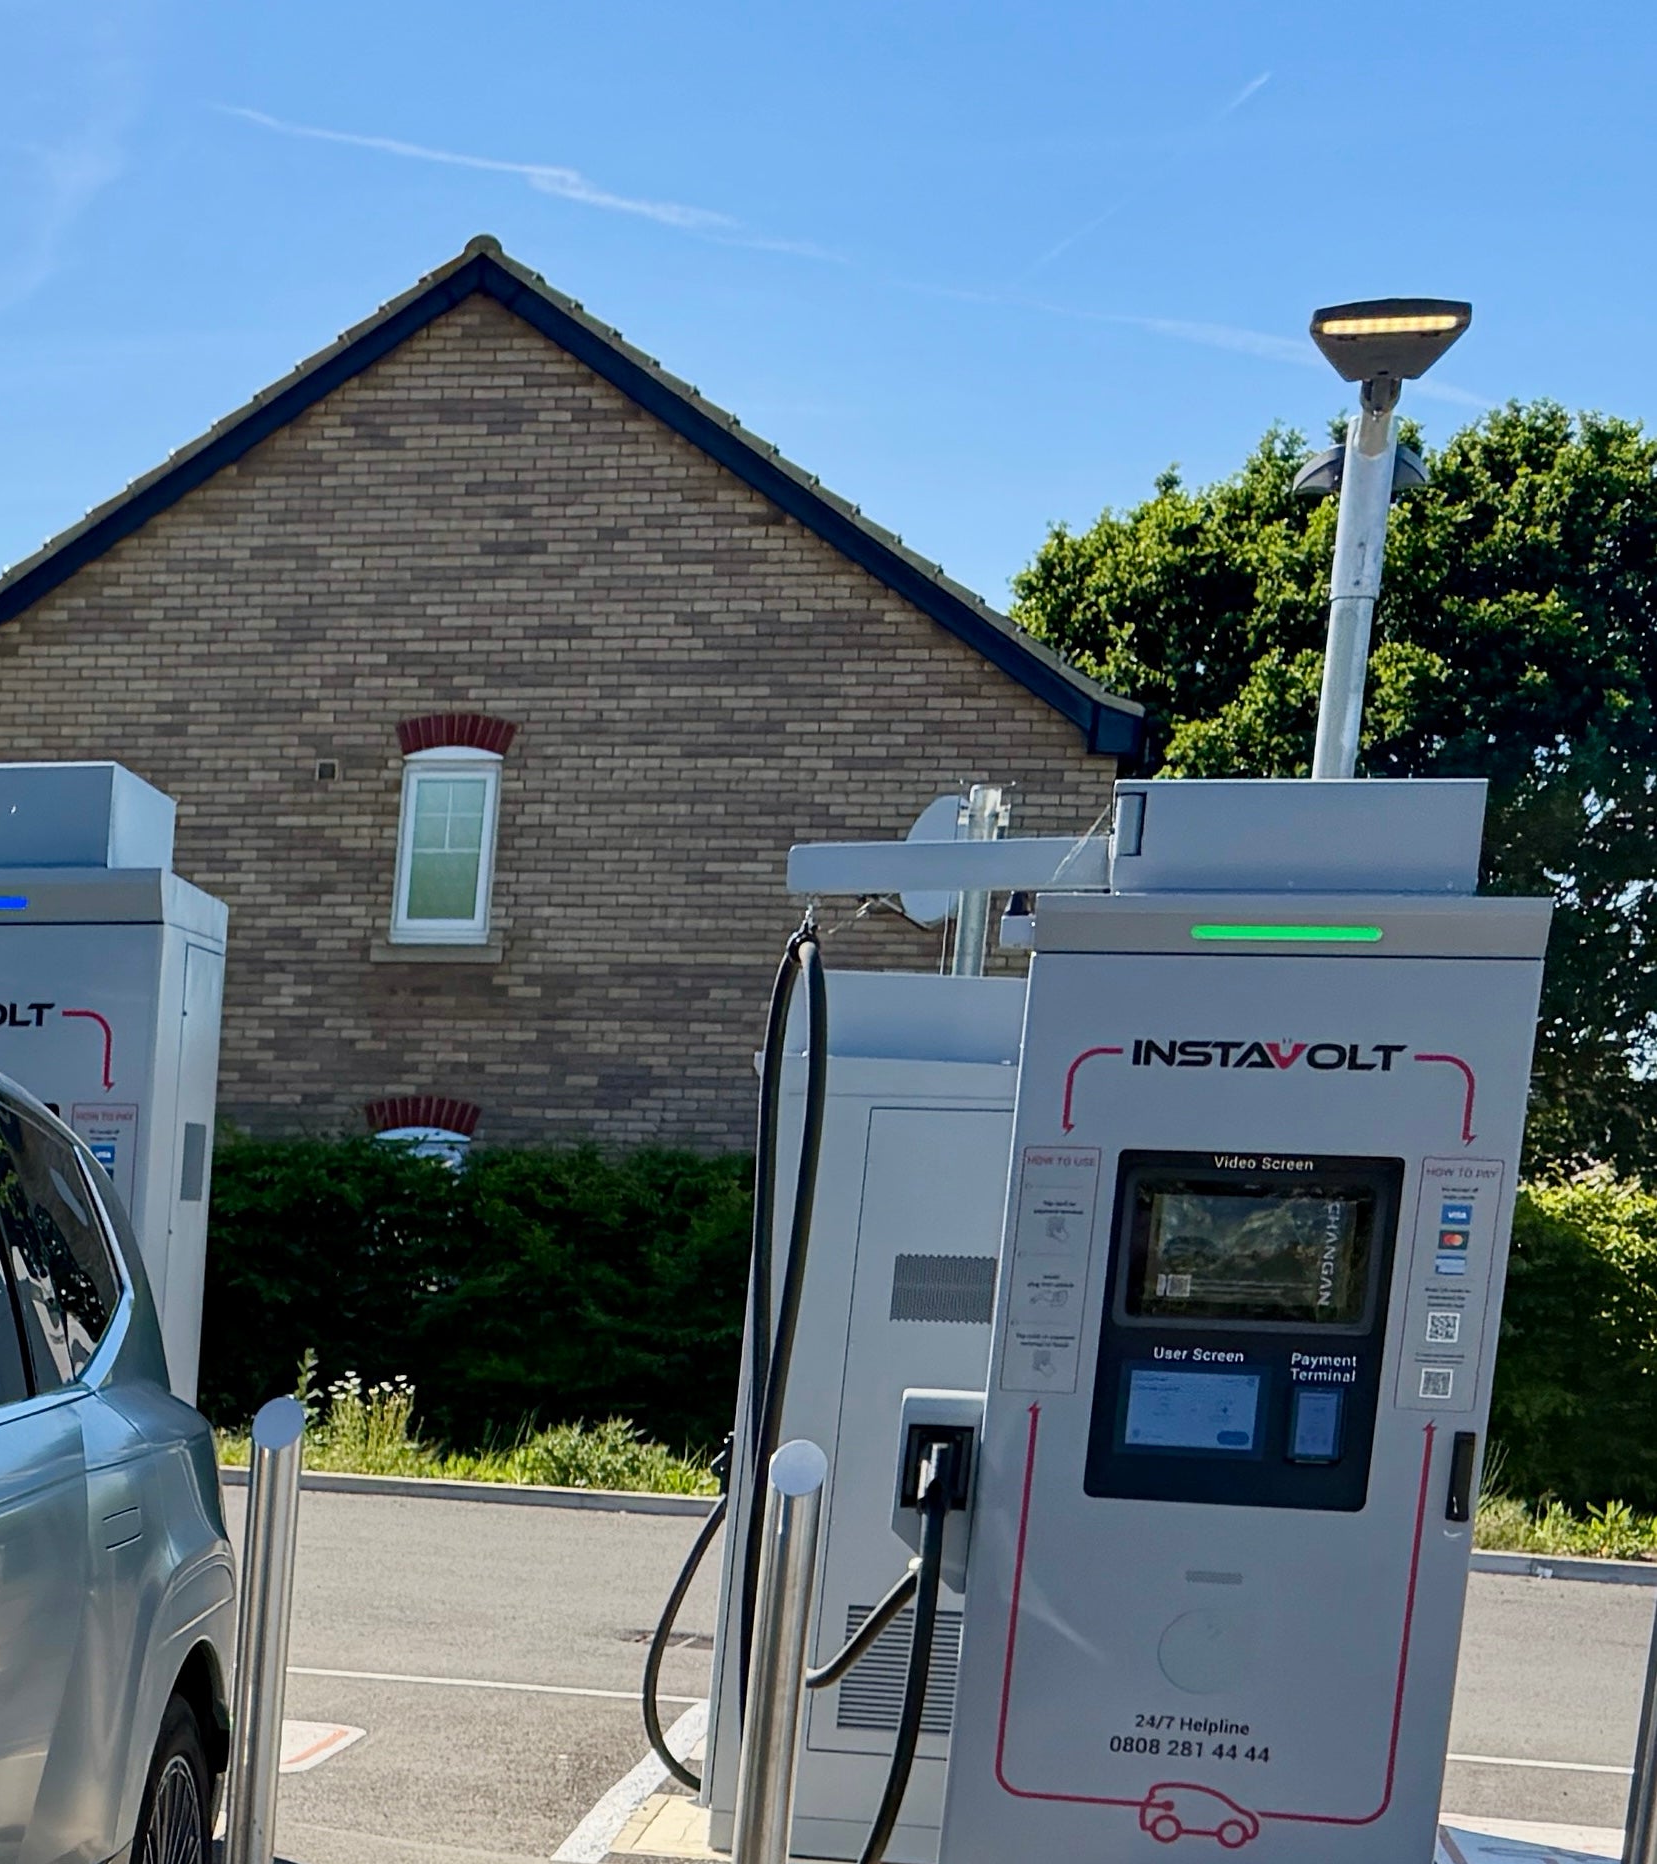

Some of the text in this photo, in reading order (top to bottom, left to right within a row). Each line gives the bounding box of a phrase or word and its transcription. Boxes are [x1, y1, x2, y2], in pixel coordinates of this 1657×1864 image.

[1132, 1037, 1408, 1071] INSTAVOLT
[1214, 1155, 1314, 1171] Video Screen
[1317, 1200, 1342, 1307] CHANGAN
[1154, 1346, 1244, 1362] User Screen
[1291, 1352, 1356, 1369] Payment
[1290, 1368, 1356, 1382] Terminal
[1135, 1714, 1250, 1736] 24/7 Helpline
[1109, 1735, 1270, 1763] 0808 281 44 44
